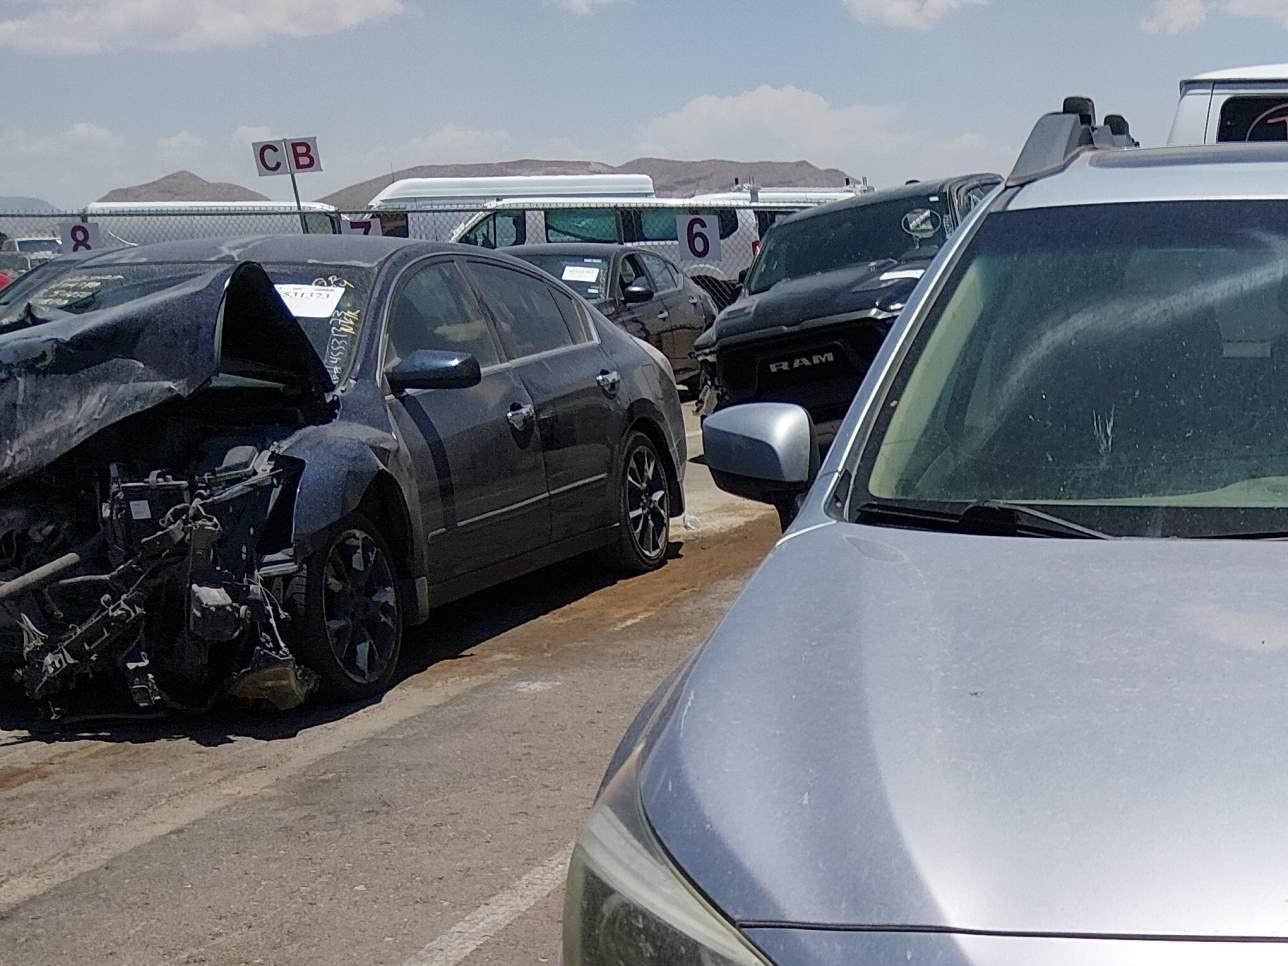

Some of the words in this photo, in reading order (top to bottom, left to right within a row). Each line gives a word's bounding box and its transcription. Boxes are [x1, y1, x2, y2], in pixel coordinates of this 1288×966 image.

[259, 144, 281, 171] C
[291, 142, 315, 170] B
[686, 217, 710, 258] 6
[769, 352, 835, 373] RAM
